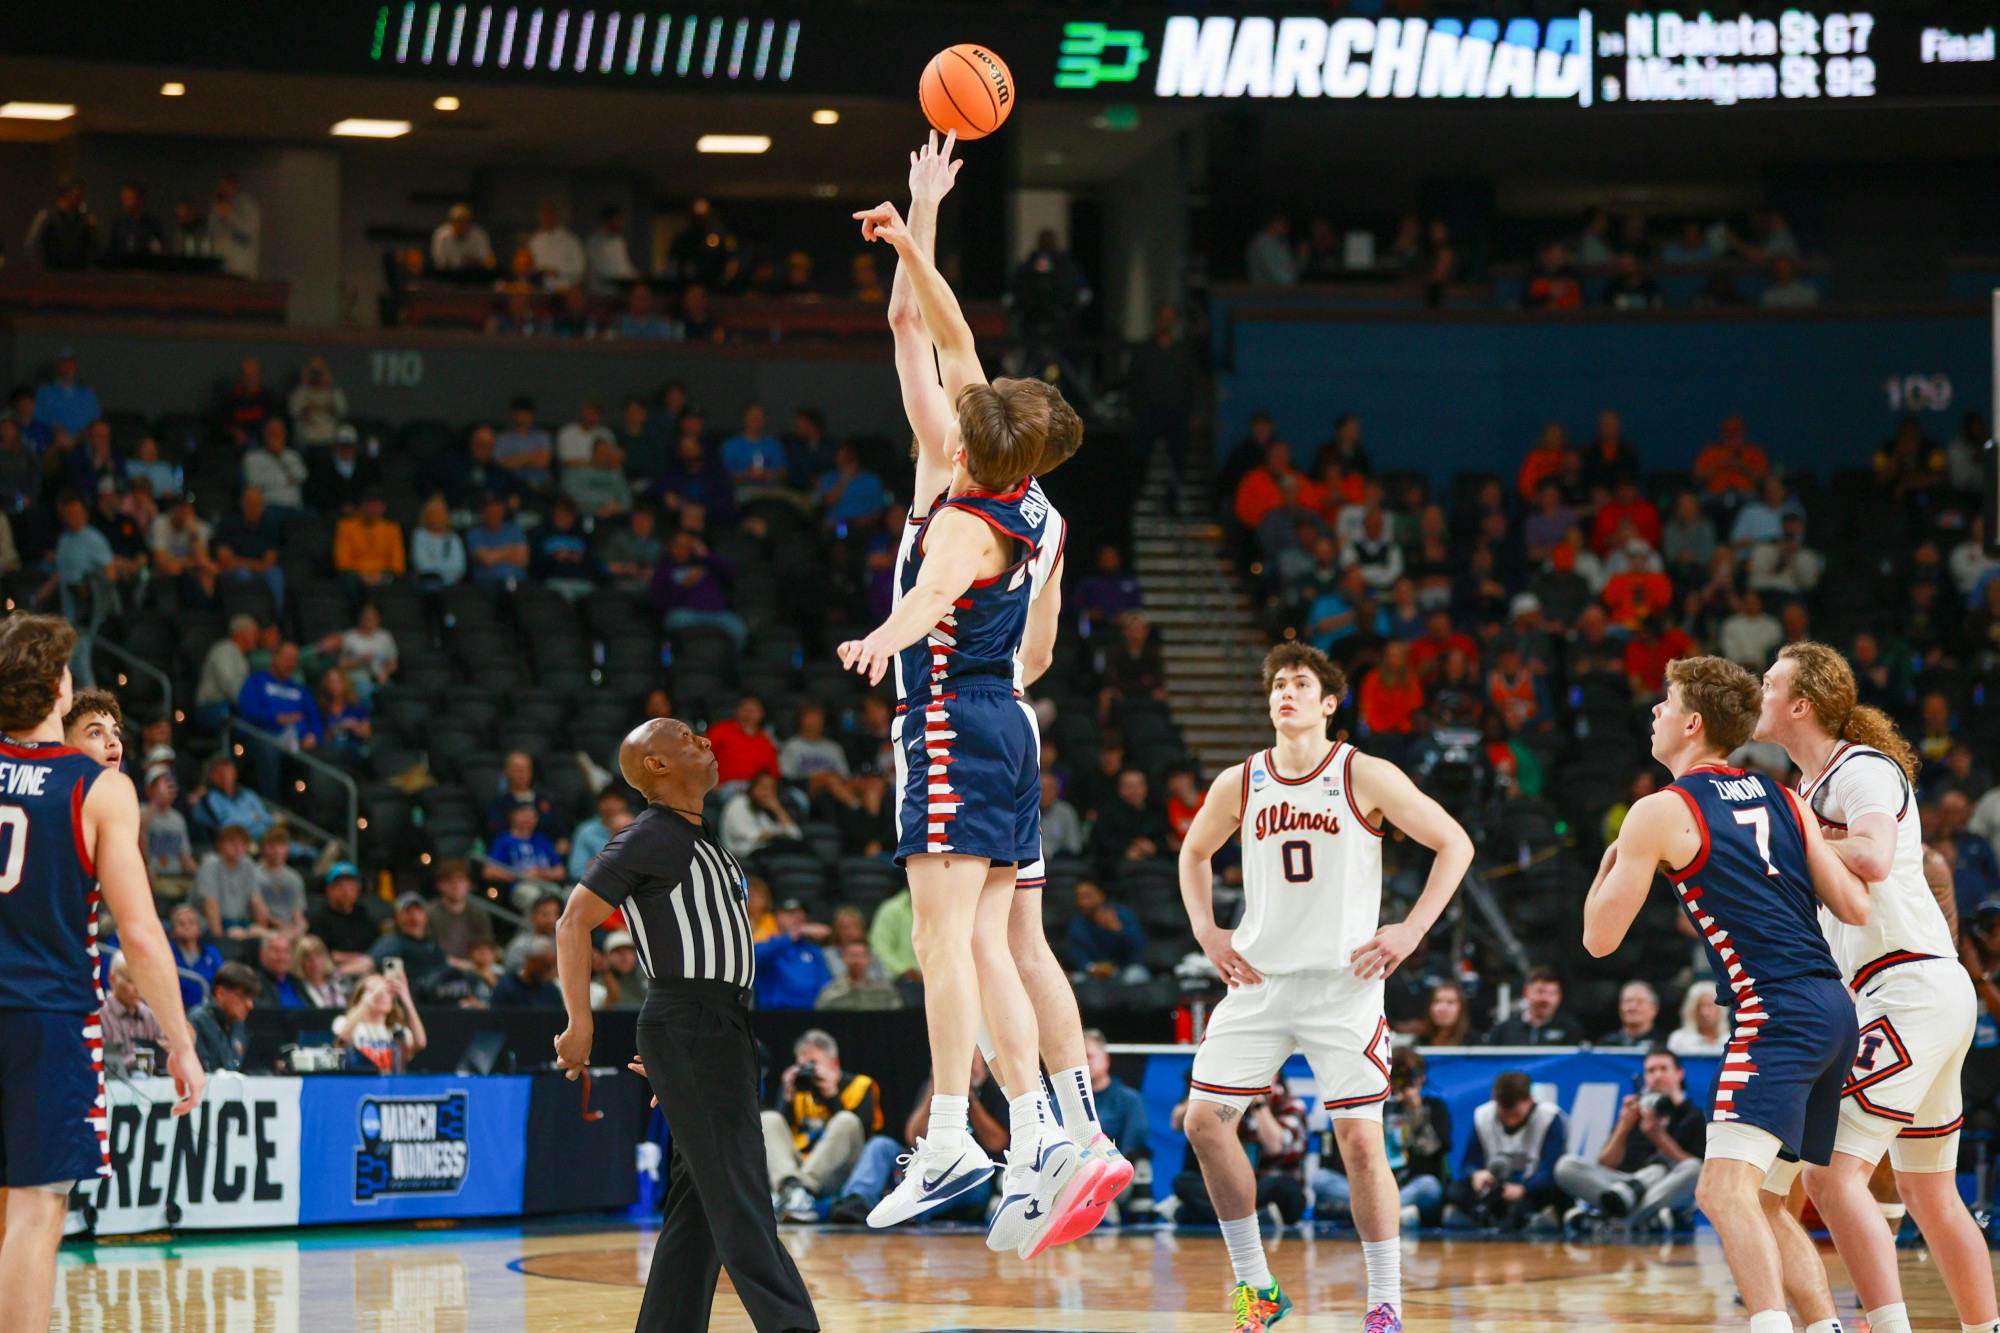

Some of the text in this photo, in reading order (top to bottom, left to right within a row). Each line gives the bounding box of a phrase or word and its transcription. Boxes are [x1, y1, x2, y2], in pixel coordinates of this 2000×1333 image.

[1626, 11, 1653, 57] N
[1657, 11, 1777, 57] Dakota
[1780, 9, 1821, 55] St
[1823, 11, 1874, 54] 67
[1920, 26, 1995, 62] Final
[1626, 56, 1777, 105] Michigan
[1780, 56, 1821, 99] St
[1825, 56, 1876, 97] 92
[371, 350, 423, 387] 110
[1886, 374, 1951, 411] 109
[1255, 801, 1340, 841] Illinois
[1731, 805, 1781, 876] 7
[1281, 840, 1313, 883] 0
[380, 1103, 438, 1142] MARCH
[391, 1140, 467, 1180] MADNESS
